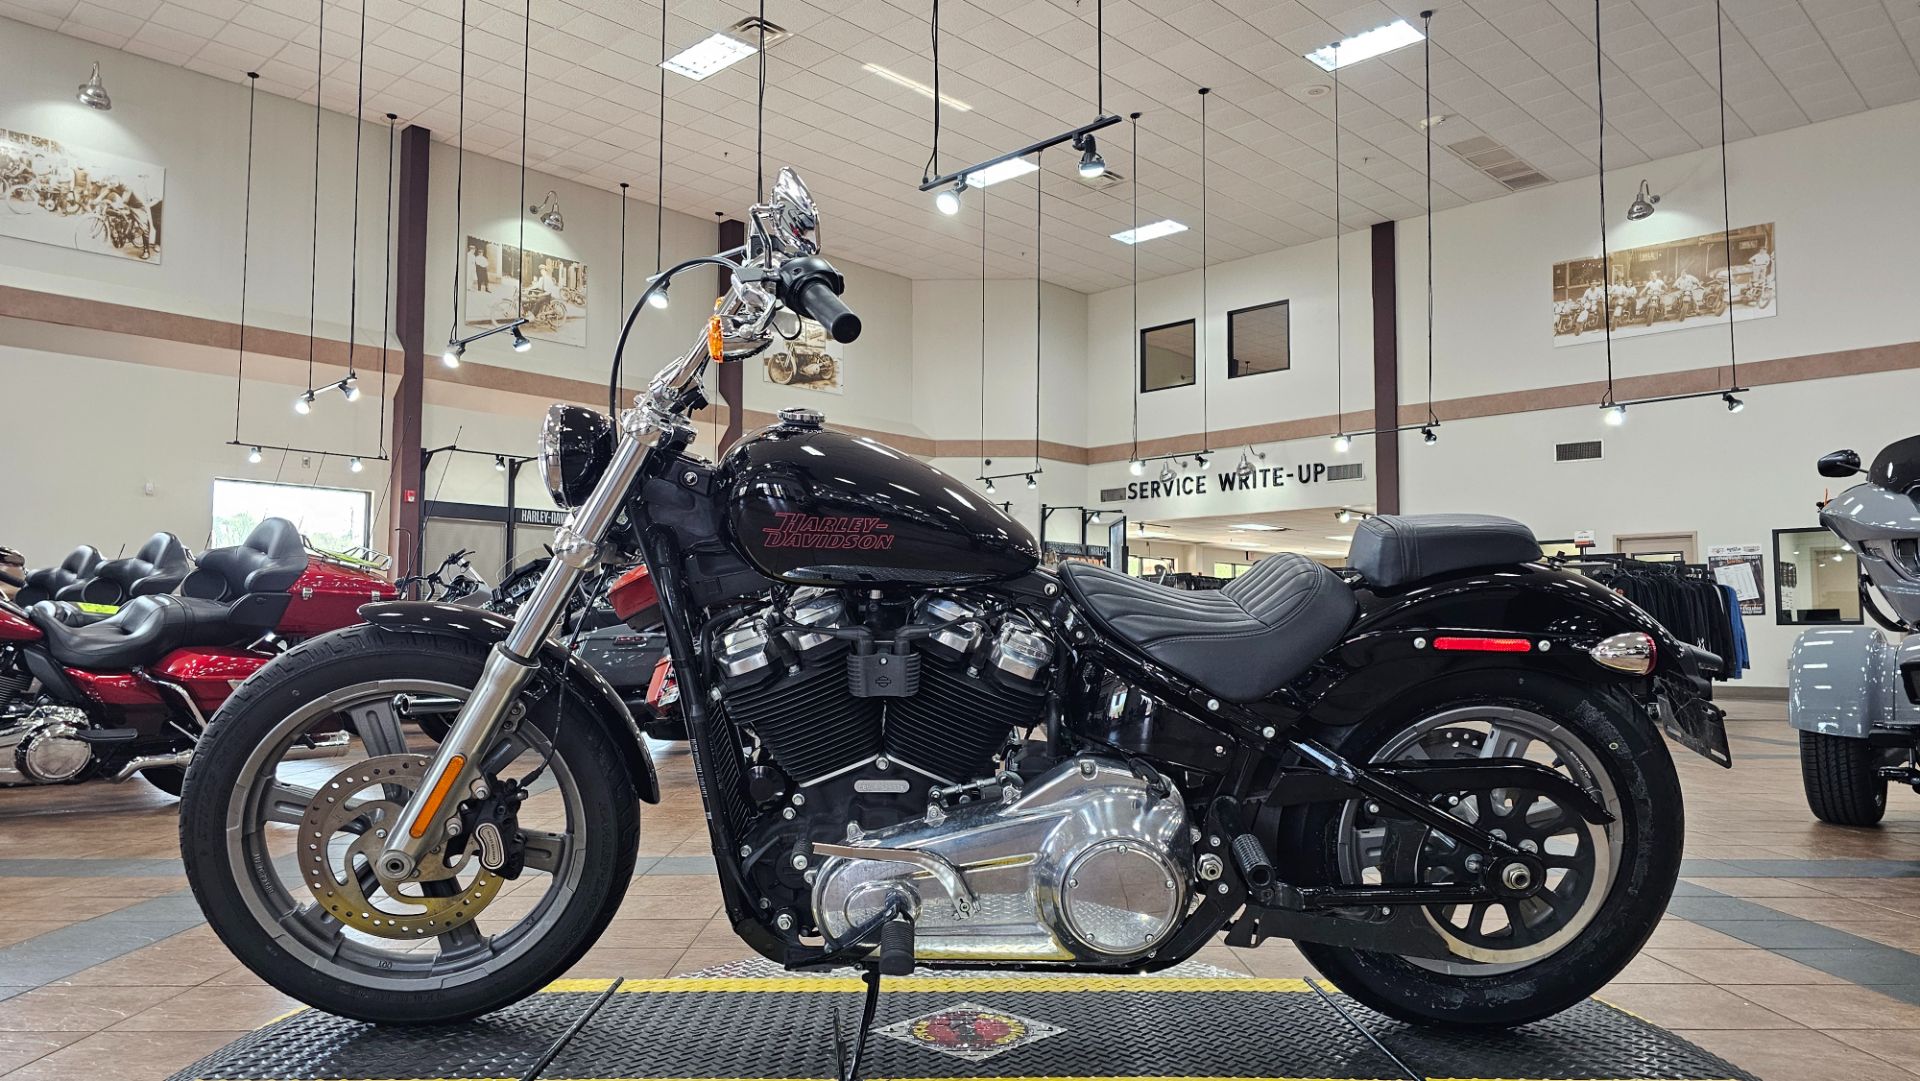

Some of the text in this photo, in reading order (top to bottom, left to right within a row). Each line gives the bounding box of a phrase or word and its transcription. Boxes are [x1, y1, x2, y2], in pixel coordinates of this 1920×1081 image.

[1127, 463, 1326, 500] SERVICE WRITE-UP
[762, 512, 889, 533] HARLEY-
[764, 531, 896, 550] DAVIDSON
